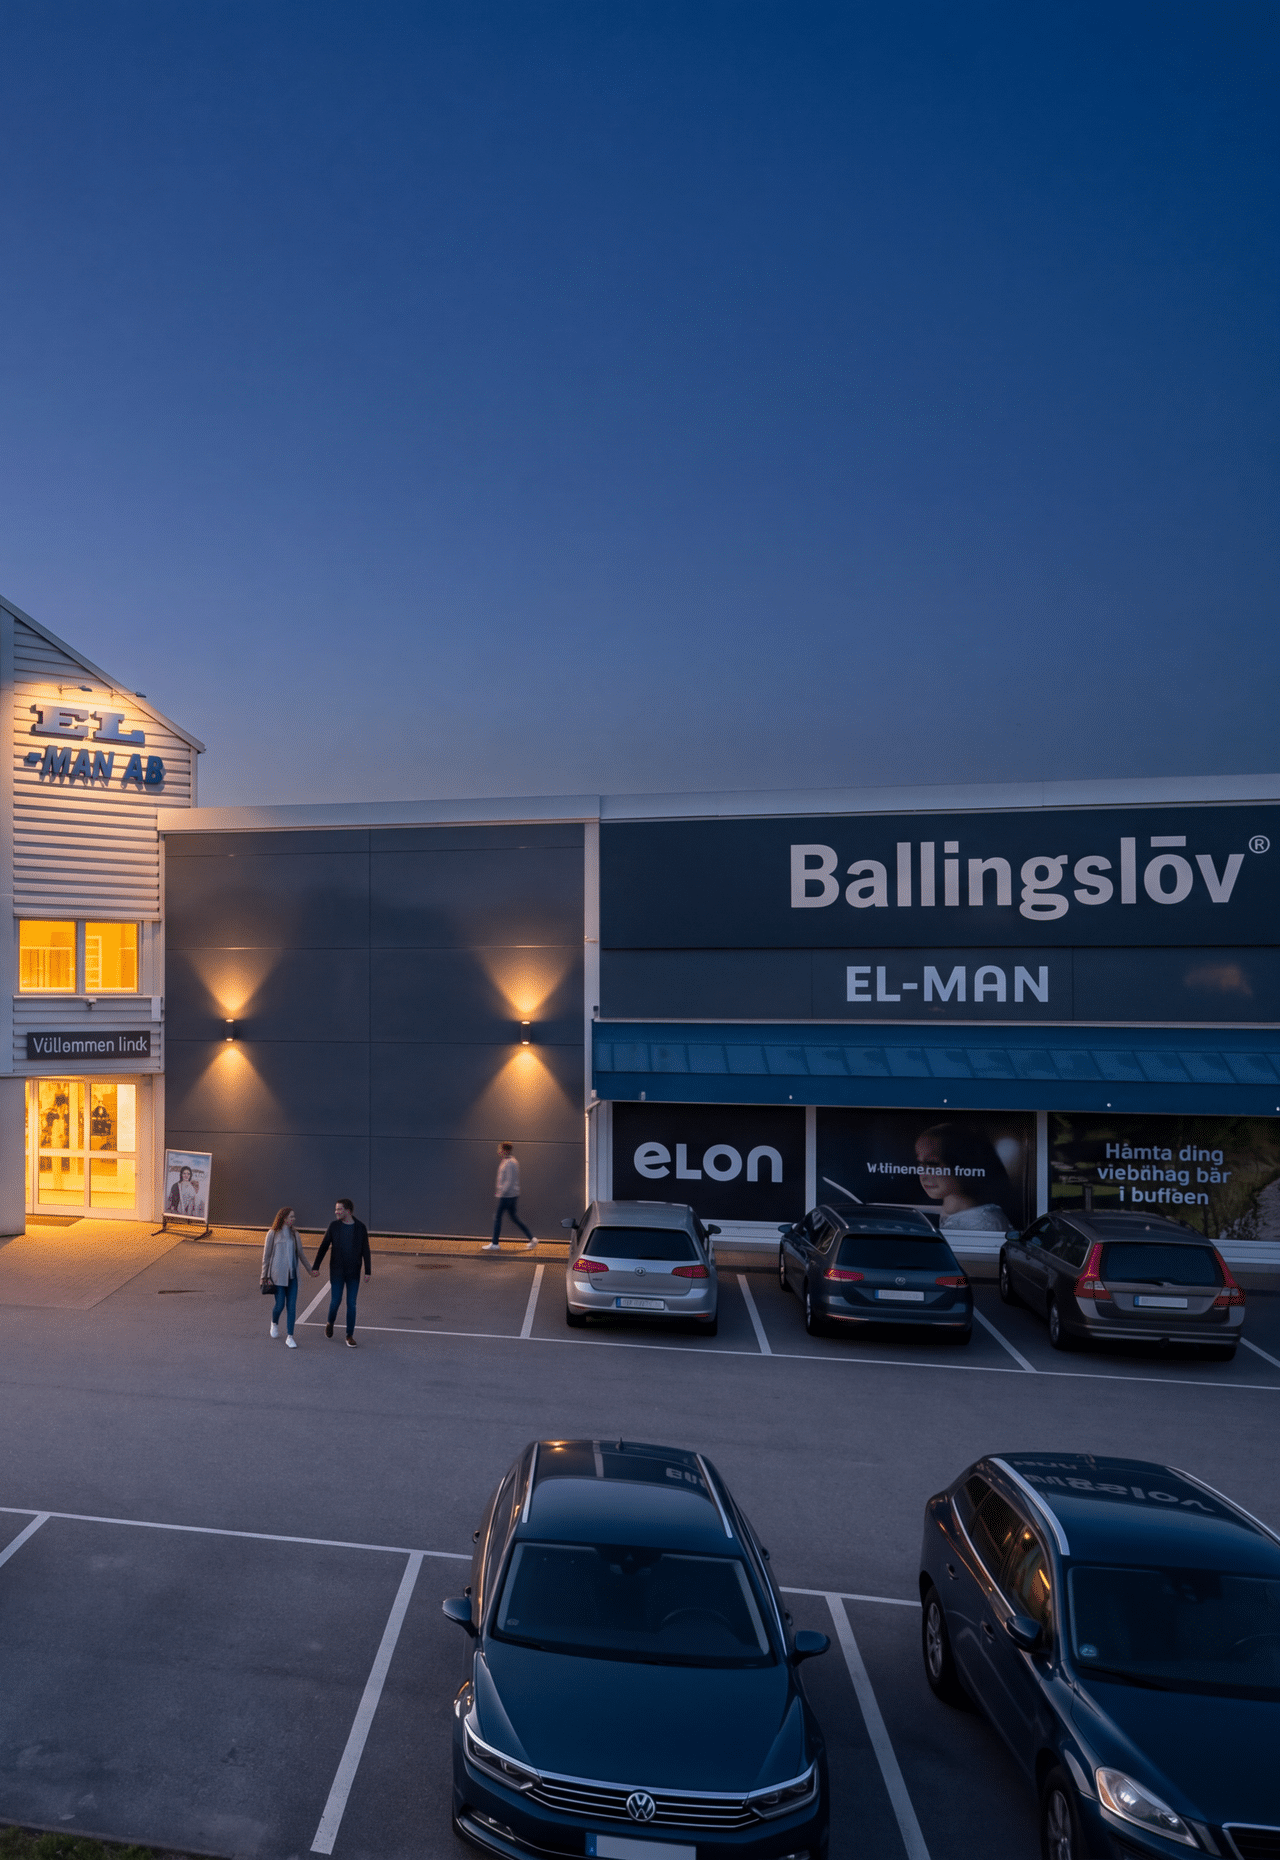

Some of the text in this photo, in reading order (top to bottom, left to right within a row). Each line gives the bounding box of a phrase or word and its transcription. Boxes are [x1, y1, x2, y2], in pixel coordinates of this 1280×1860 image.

[31, 704, 146, 747] EL
[124, 754, 164, 785] AB
[846, 965, 1049, 1002] EL-MAN
[1179, 1145, 1224, 1166] ding
